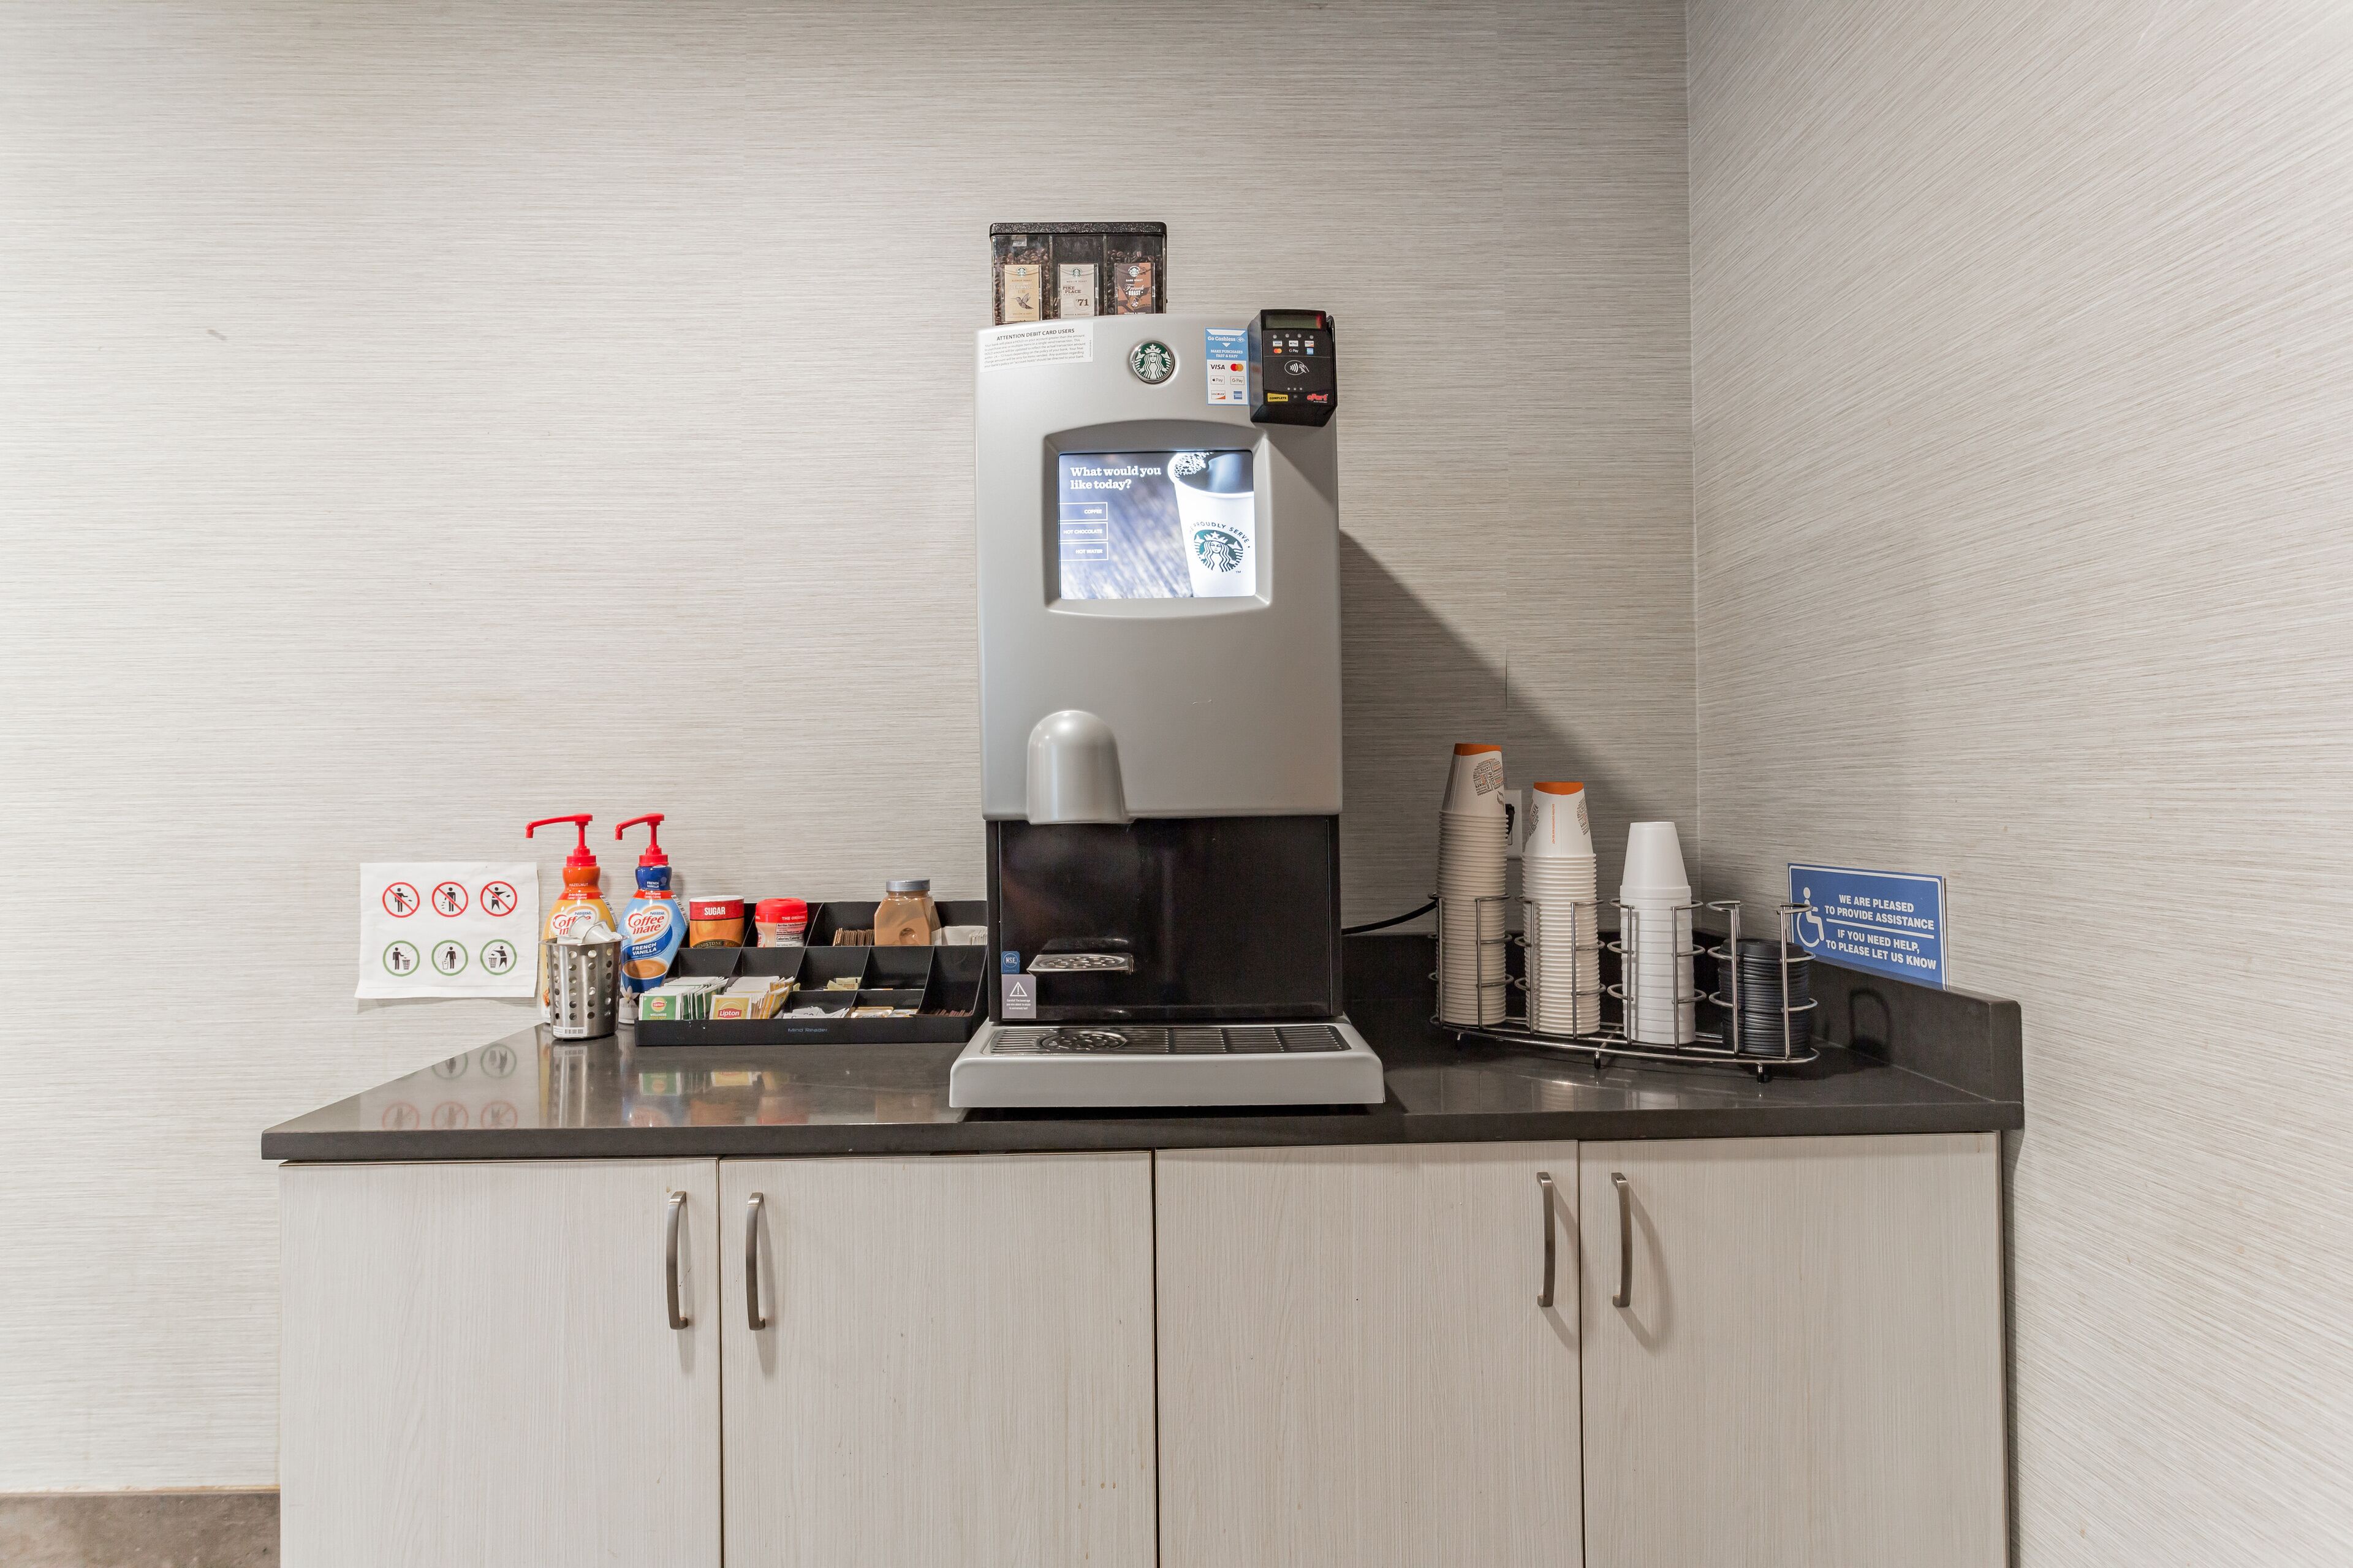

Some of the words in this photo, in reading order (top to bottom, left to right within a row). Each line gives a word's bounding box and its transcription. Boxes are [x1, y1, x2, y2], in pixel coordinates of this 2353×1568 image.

[1070, 467, 1102, 477] What
[1103, 466, 1139, 476] would
[1140, 467, 1161, 477] you
[1070, 480, 1093, 490] like
[1094, 479, 1132, 490] today?
[1229, 527, 1249, 543] SERVE
[705, 907, 726, 915] SUGAR
[1839, 894, 1852, 904] WE
[1854, 896, 1870, 907] ARE
[1873, 898, 1914, 913] PLEASED
[553, 914, 591, 929] Coffe
[628, 913, 664, 928] Coffee
[1824, 905, 1835, 914] TO
[1837, 907, 1873, 921] PROVIDE
[1876, 913, 1934, 930] ASSISTANCE
[632, 924, 661, 935] mate
[632, 942, 657, 951] FRENCH
[1837, 929, 1844, 938] IF
[1847, 930, 1865, 942] YOU
[1867, 934, 1891, 947] NEED
[1893, 939, 1920, 954] HELP,
[1825, 939, 1836, 950] TO
[1838, 942, 1870, 956] PLEASE
[1872, 949, 1889, 960] LET
[1891, 953, 1903, 963] US
[1906, 955, 1937, 970] KNOW
